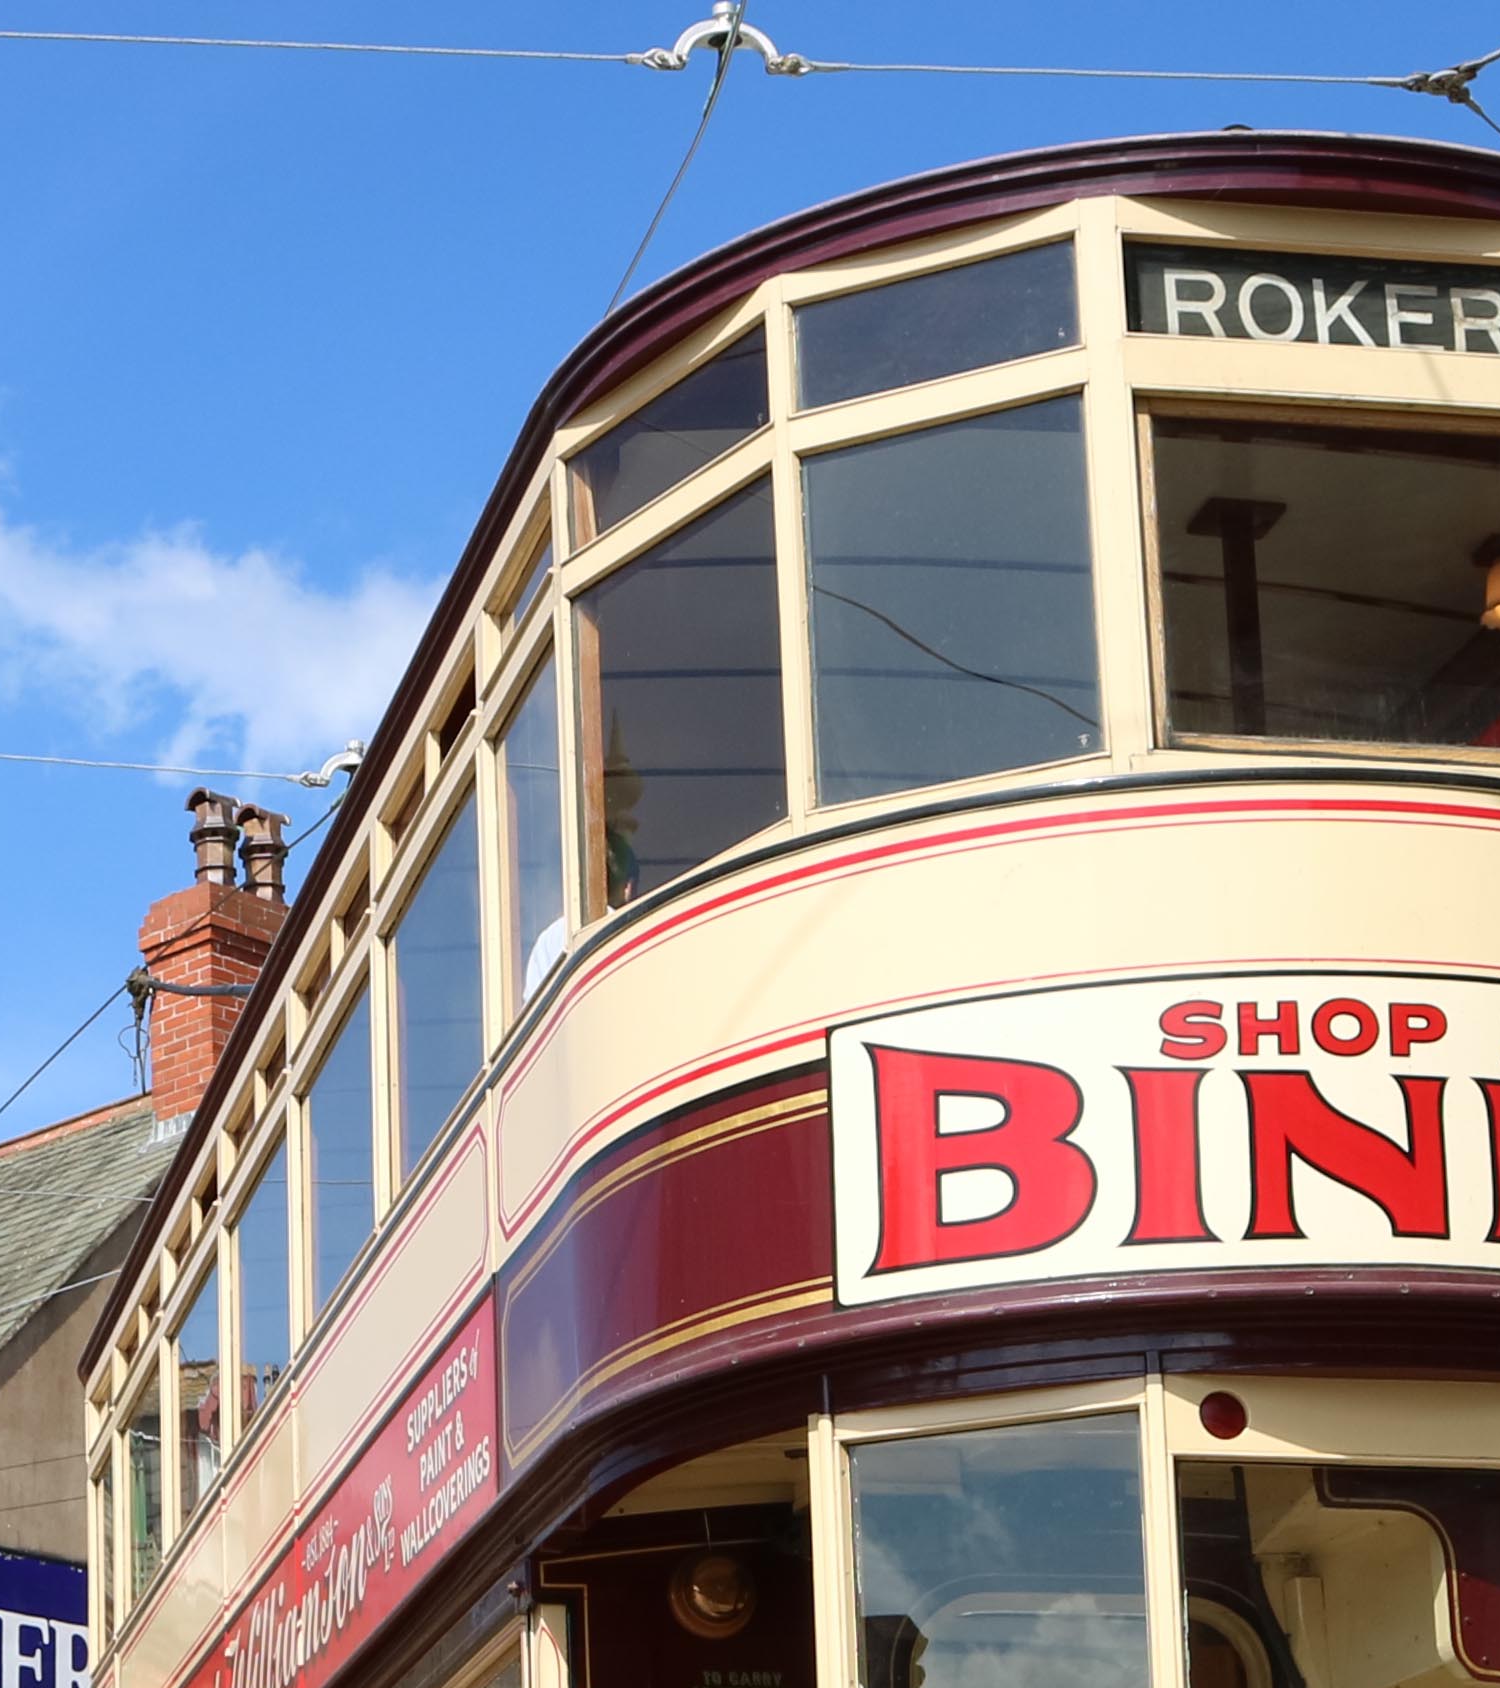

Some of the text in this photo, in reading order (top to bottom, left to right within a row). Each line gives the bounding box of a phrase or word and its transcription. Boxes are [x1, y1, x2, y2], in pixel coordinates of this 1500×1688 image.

[1159, 998, 1448, 1061] SHOP
[407, 1347, 468, 1453] SUPPLIERS
[419, 1410, 465, 1492] PAINT &
[400, 1435, 490, 1567] WALLCOVERINGS
[728, 1672, 783, 1686] CARRY
